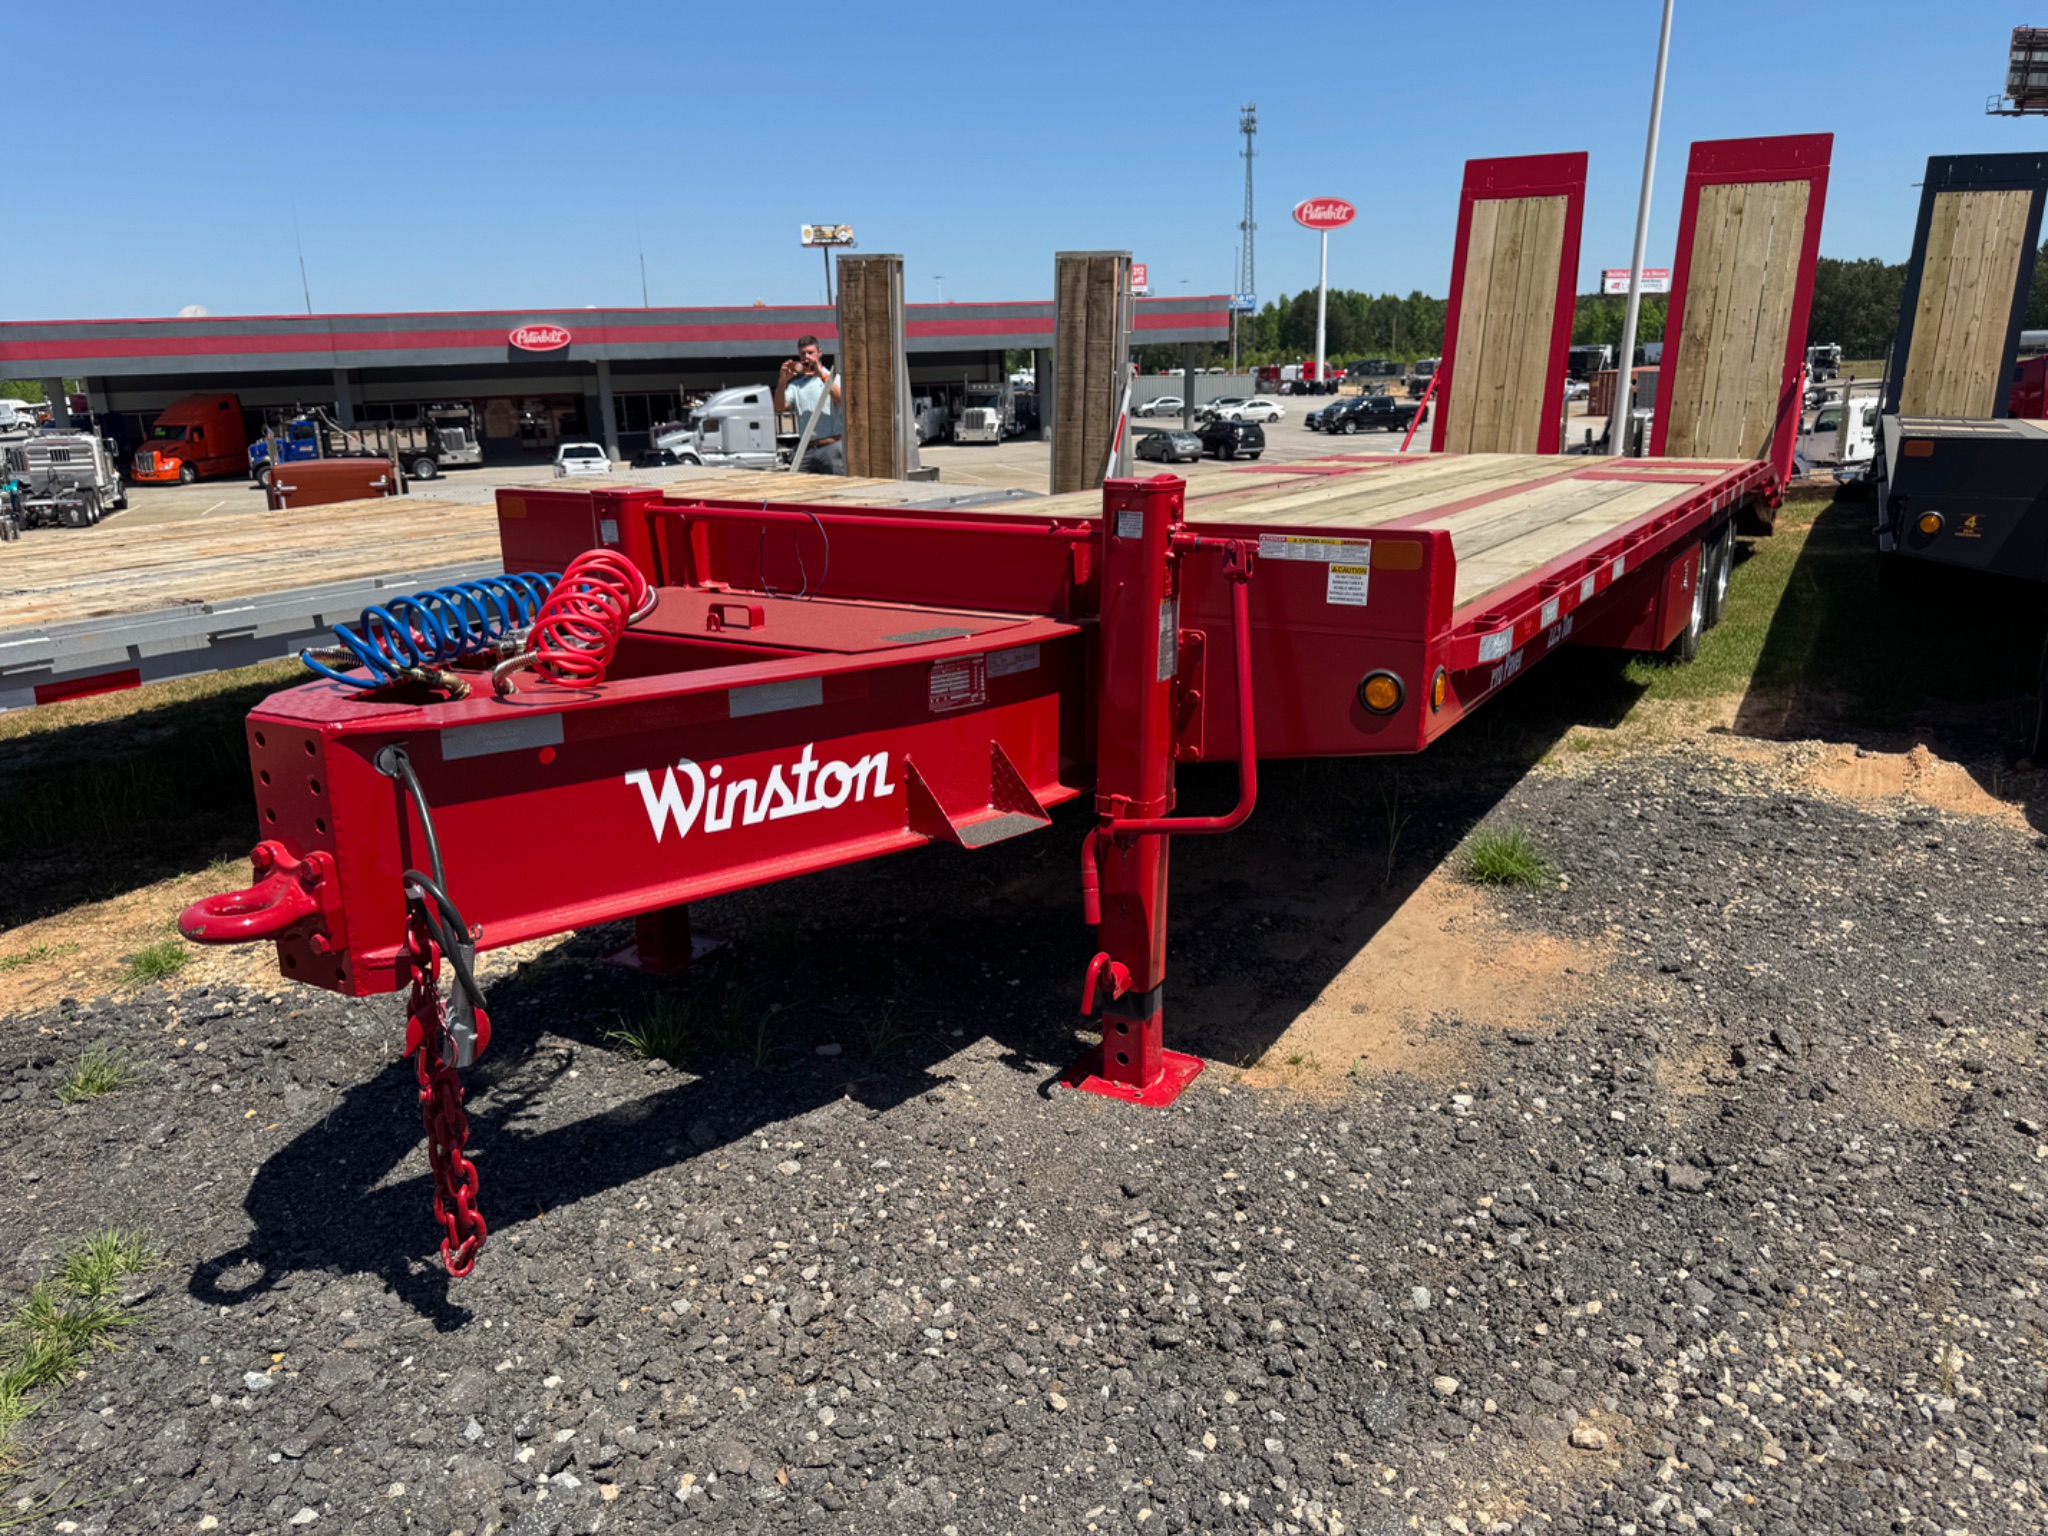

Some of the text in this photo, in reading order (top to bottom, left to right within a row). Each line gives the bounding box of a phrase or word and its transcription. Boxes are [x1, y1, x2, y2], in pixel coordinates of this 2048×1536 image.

[1302, 202, 1351, 221] Peterbilt
[517, 329, 565, 345] Peterbilt
[1338, 566, 1367, 575] CAUTION
[624, 742, 895, 844] Winston
